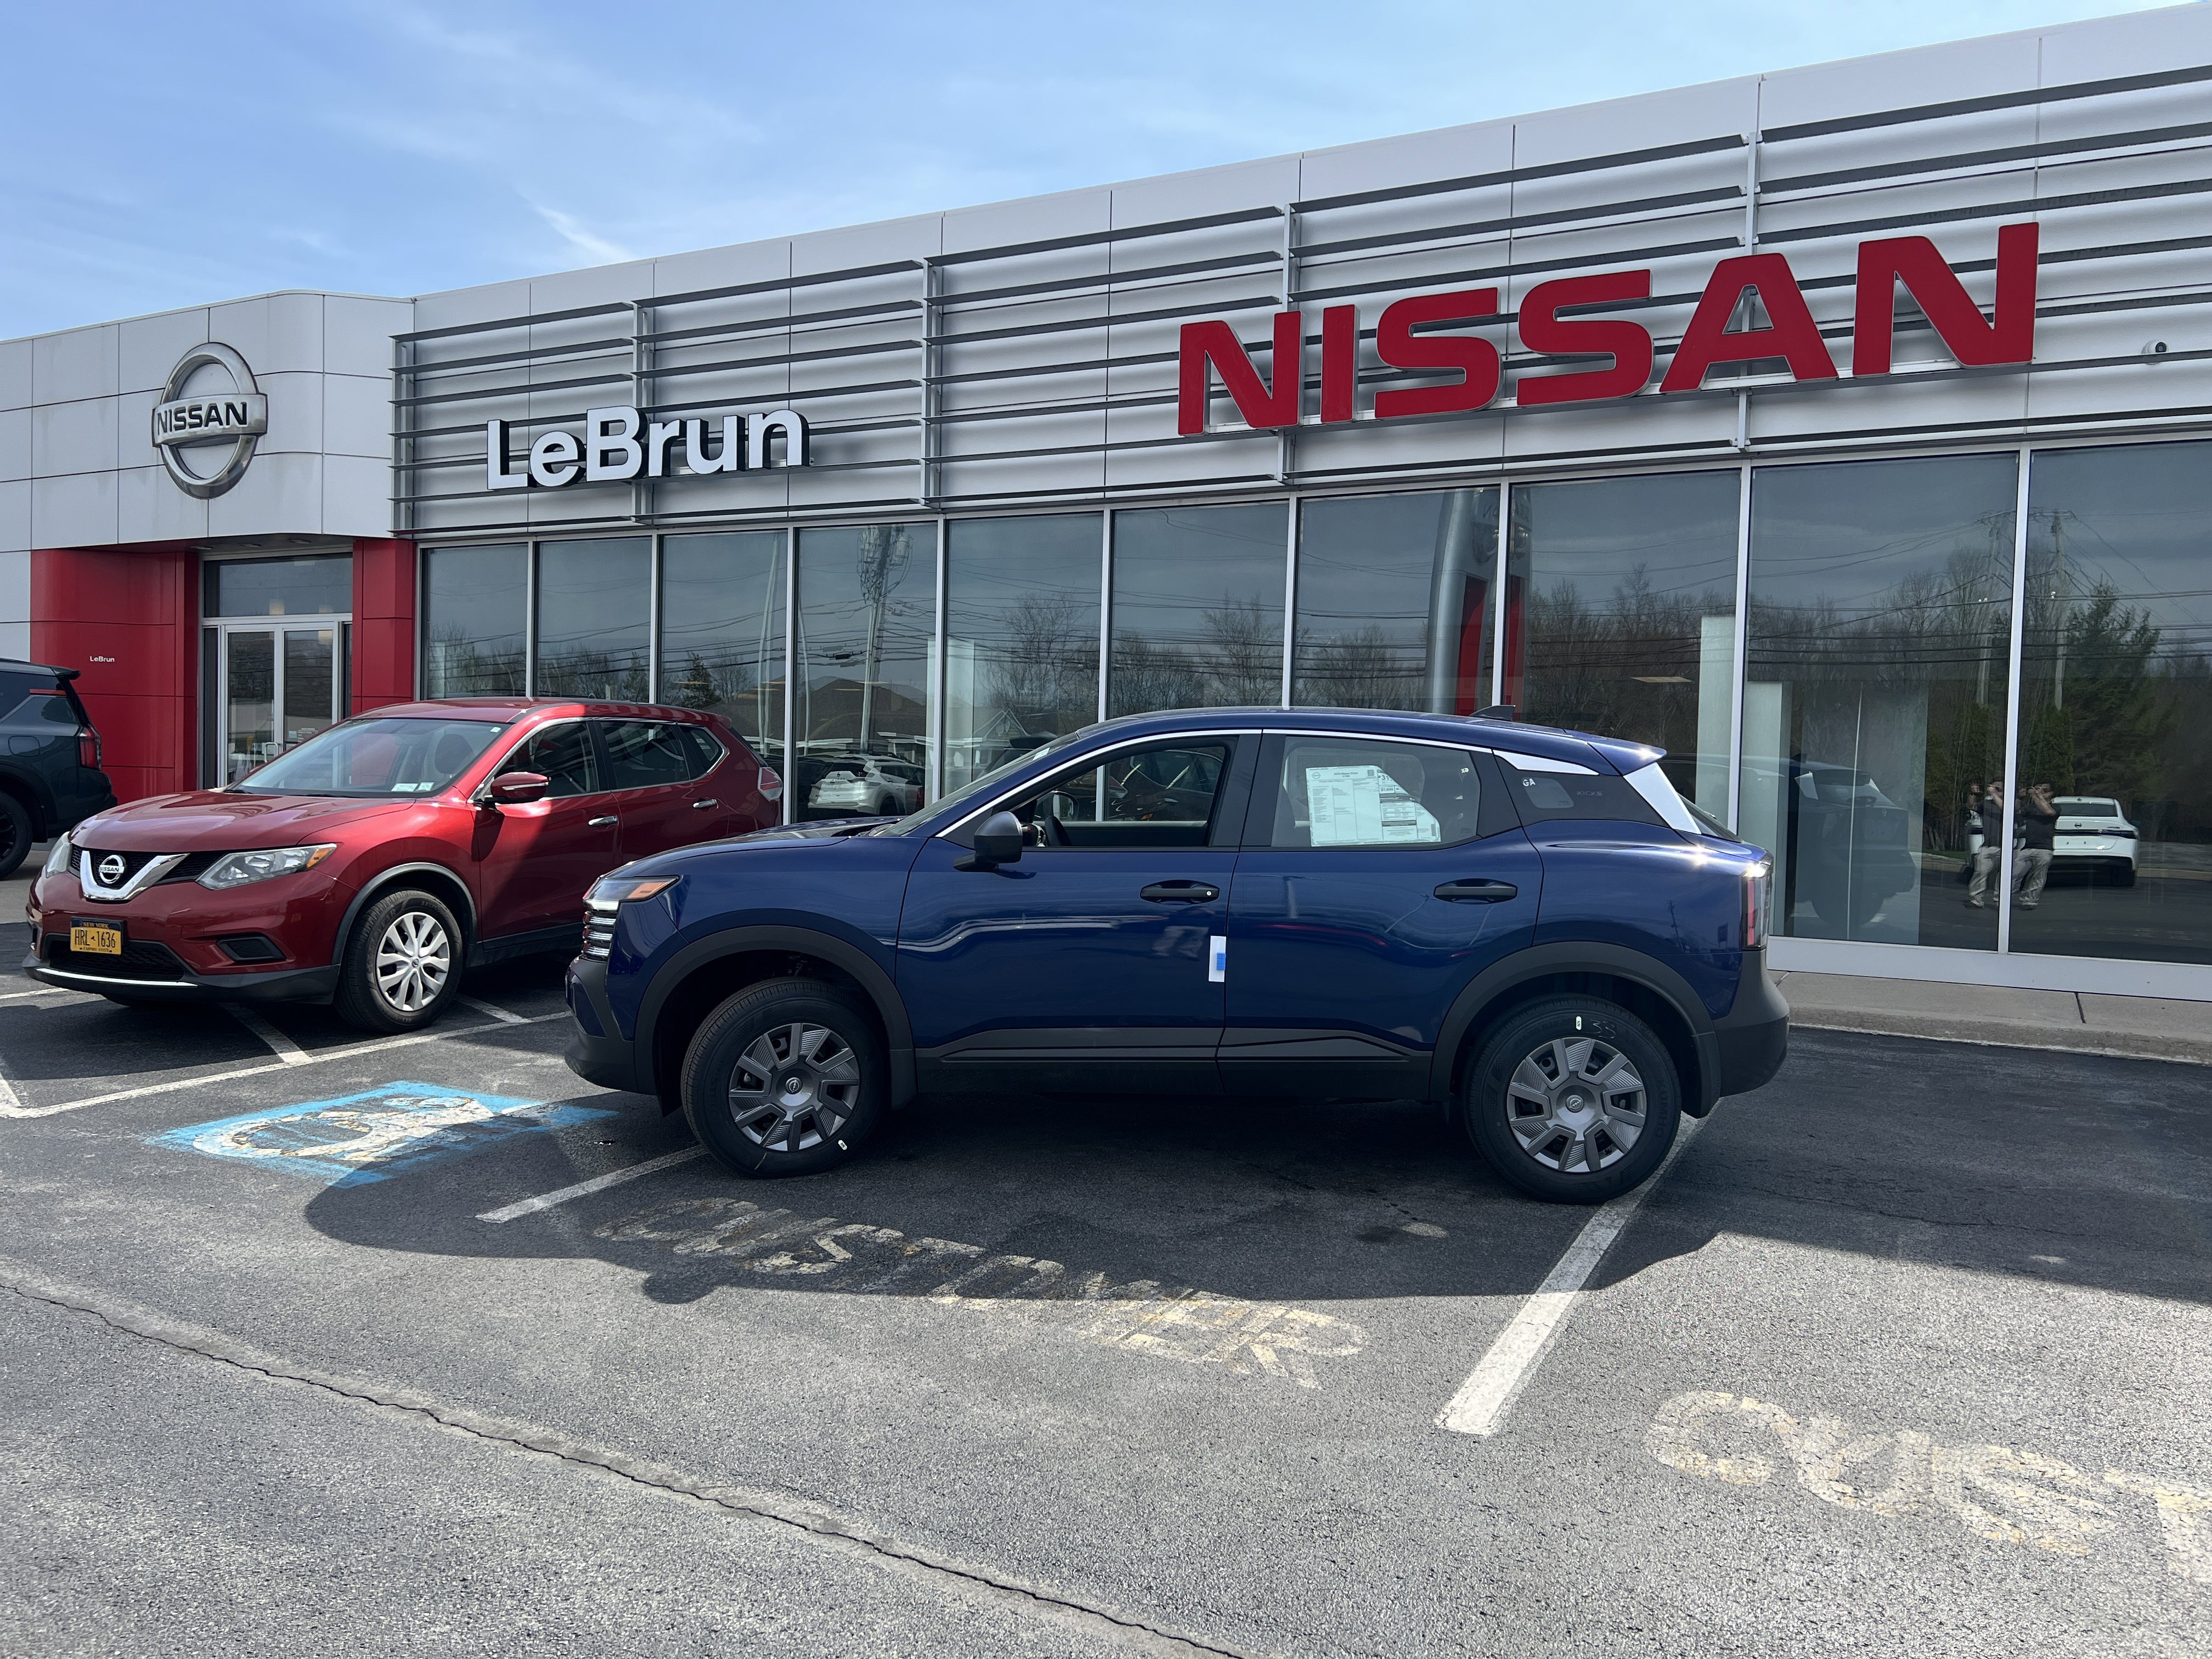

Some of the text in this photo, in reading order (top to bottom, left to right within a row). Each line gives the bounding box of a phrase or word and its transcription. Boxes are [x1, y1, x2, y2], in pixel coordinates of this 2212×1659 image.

[1177, 222, 2040, 437] NISSAN
[157, 401, 247, 436] NISSAN
[487, 405, 810, 490] LeBrun
[1522, 778, 1536, 787] GA
[75, 929, 116, 948] HRL 1636
